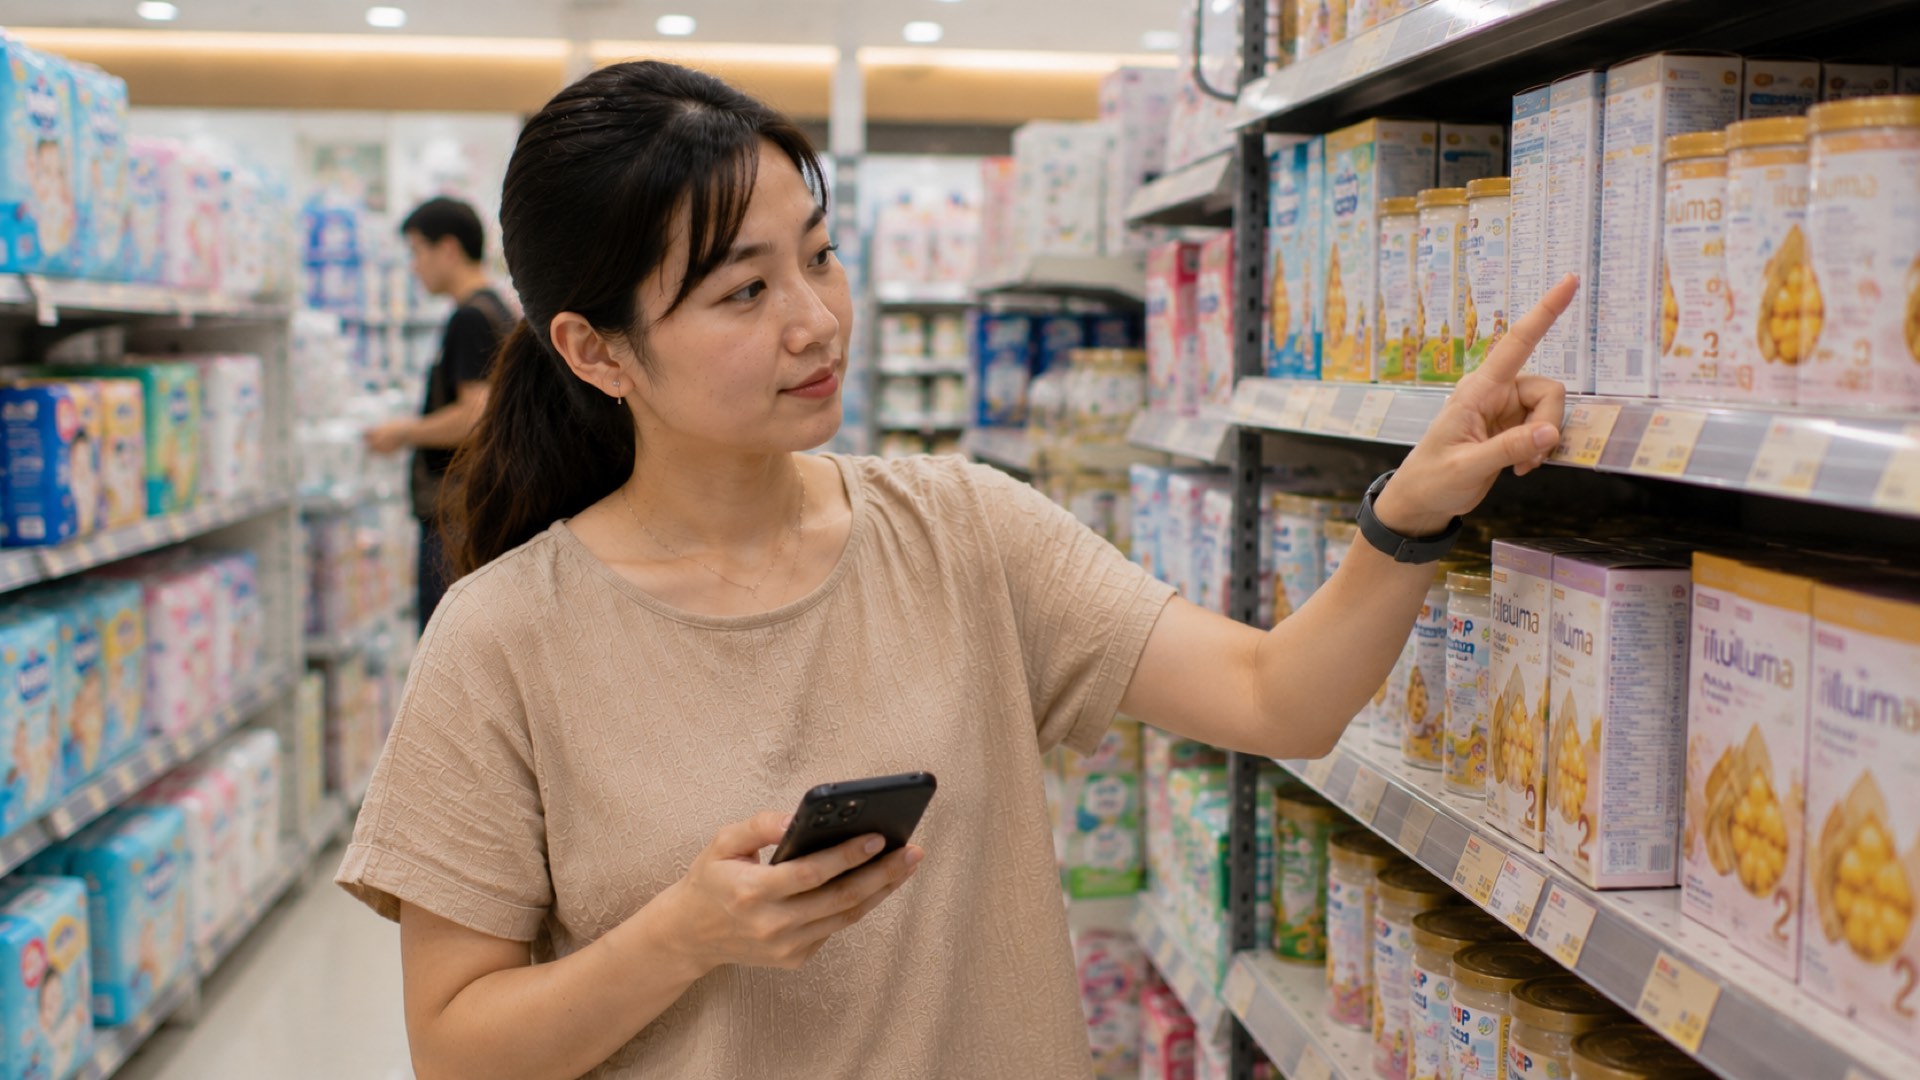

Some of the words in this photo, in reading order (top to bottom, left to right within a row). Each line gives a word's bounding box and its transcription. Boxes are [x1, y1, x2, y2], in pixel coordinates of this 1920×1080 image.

[1577, 813, 1590, 861] 2
[1773, 887, 1792, 943] 2
[1892, 956, 1919, 1021] 2
